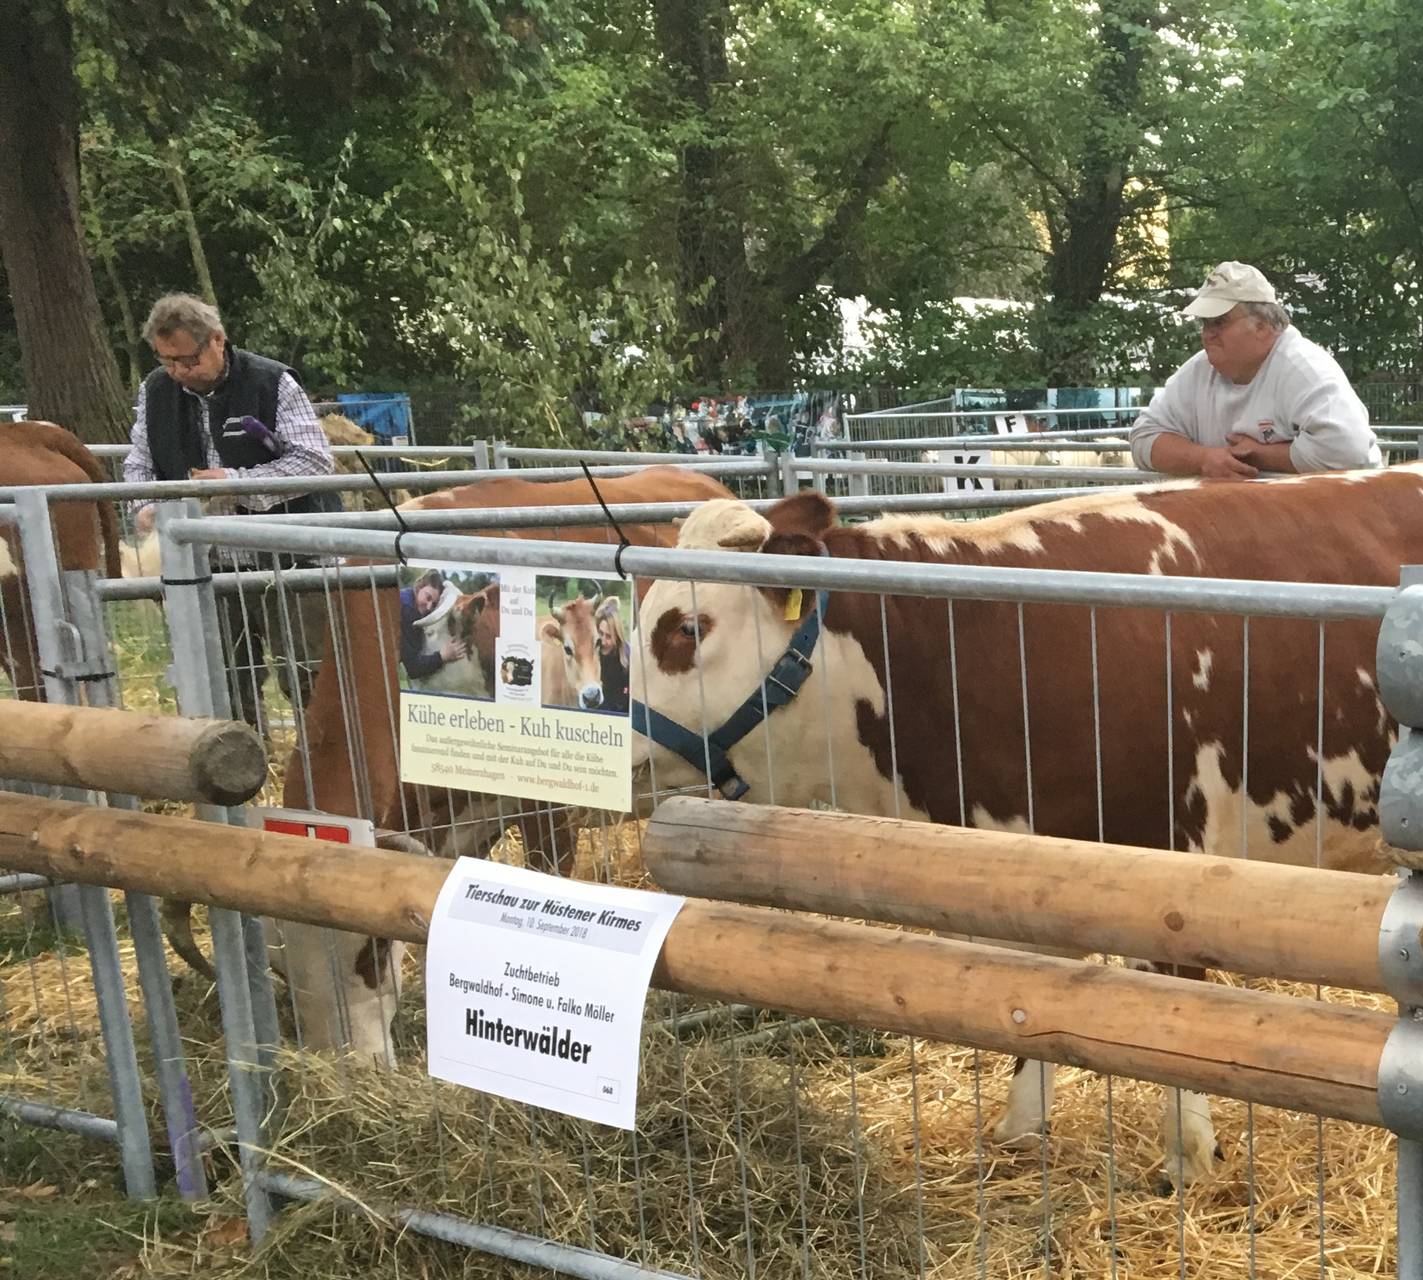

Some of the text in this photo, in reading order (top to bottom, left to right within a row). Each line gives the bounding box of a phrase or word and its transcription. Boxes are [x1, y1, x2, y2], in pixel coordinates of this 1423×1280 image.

[1004, 414, 1017, 433] F
[954, 455, 984, 490] K
[407, 703, 446, 726] Kühe
[449, 708, 505, 733] erleben
[520, 716, 551, 739] Kuh
[556, 719, 624, 748] kuscheln
[537, 758, 547, 769] Du
[548, 760, 561, 771] und
[562, 762, 572, 772] Du
[464, 883, 642, 932] Tierschau zur Hüstener Kirmes
[500, 912, 587, 939] Montag 10 September 2018
[503, 961, 561, 987] Zuchtbetrieb
[449, 972, 503, 998] Bergwaldhof
[511, 988, 544, 1009] Simone
[546, 998, 555, 1010] u.
[557, 996, 582, 1016] Falko
[584, 1001, 616, 1023] Möller
[465, 1007, 593, 1065] Hinterwälder
